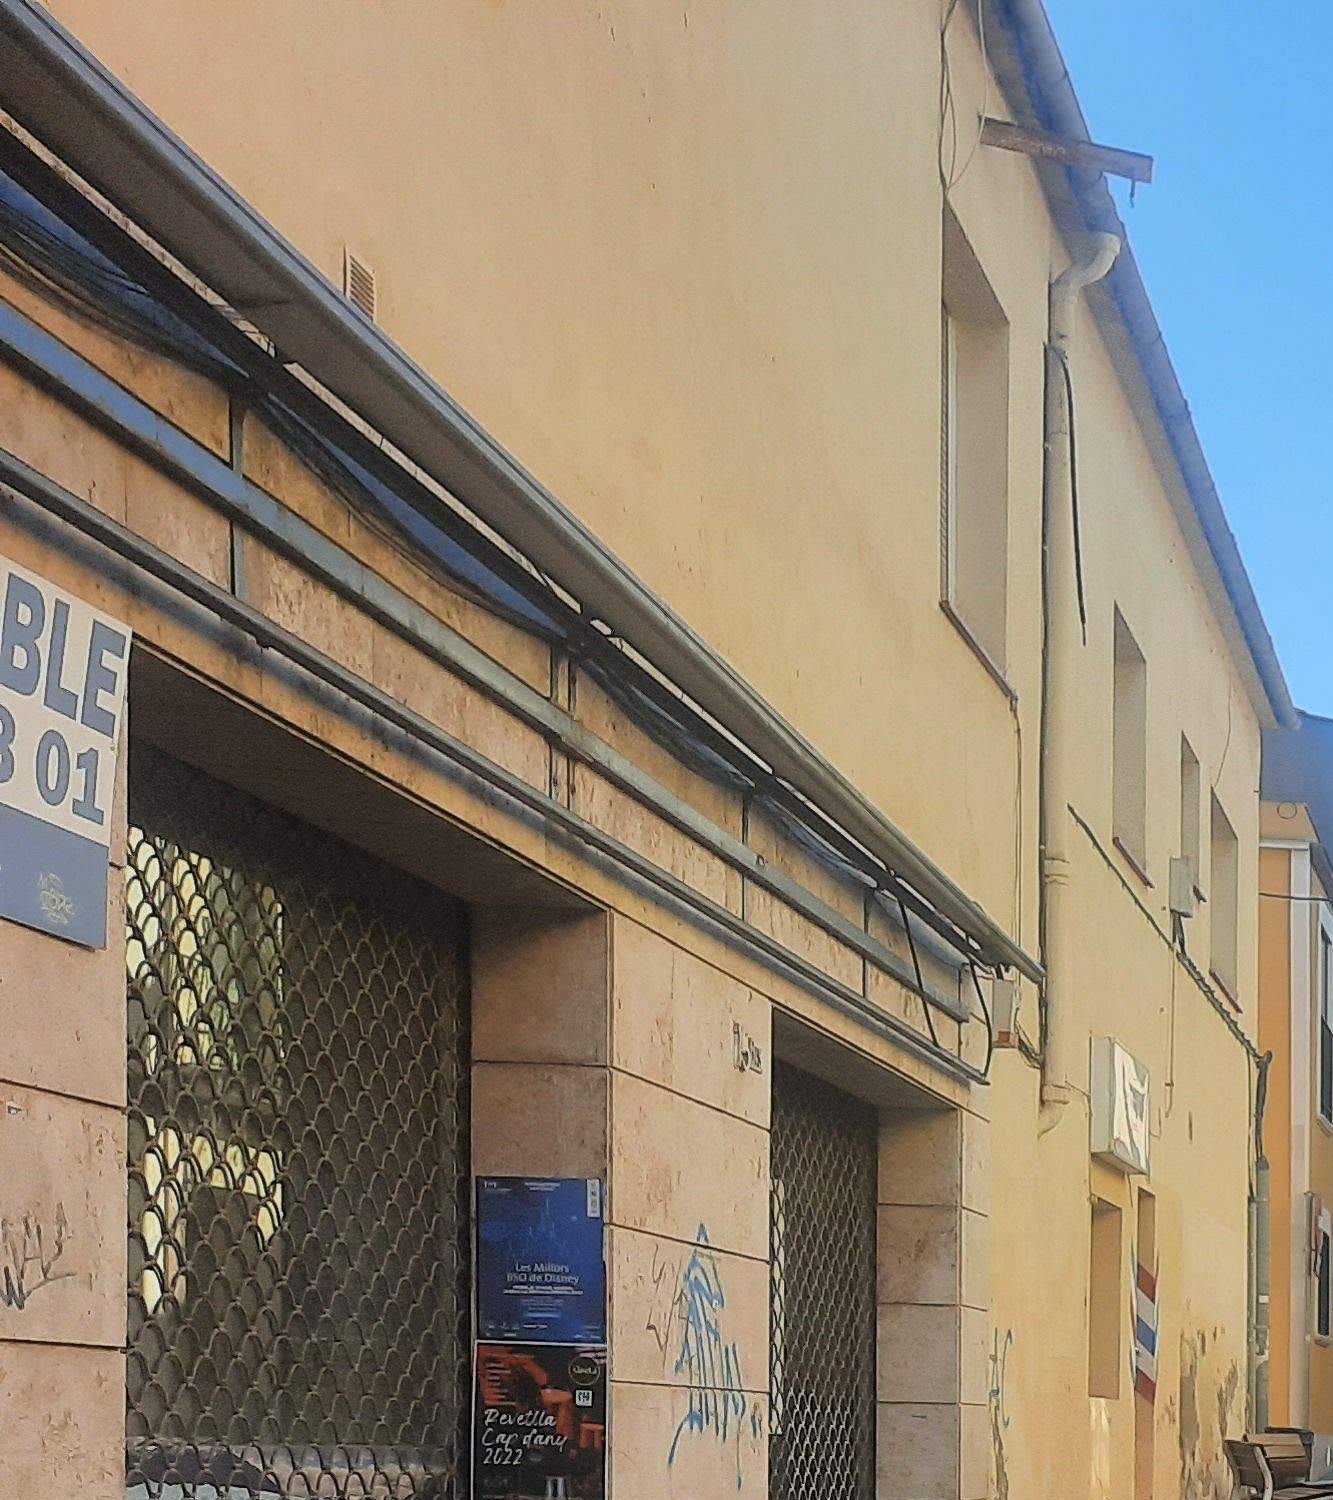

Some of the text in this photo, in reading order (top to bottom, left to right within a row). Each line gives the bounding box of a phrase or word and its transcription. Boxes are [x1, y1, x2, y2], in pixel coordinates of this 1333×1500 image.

[534, 1263, 569, 1273] Millors
[544, 1273, 579, 1284] Disney
[484, 1408, 557, 1427] Revetlla
[482, 1427, 518, 1449] Cap
[483, 1449, 522, 1466] 2022
